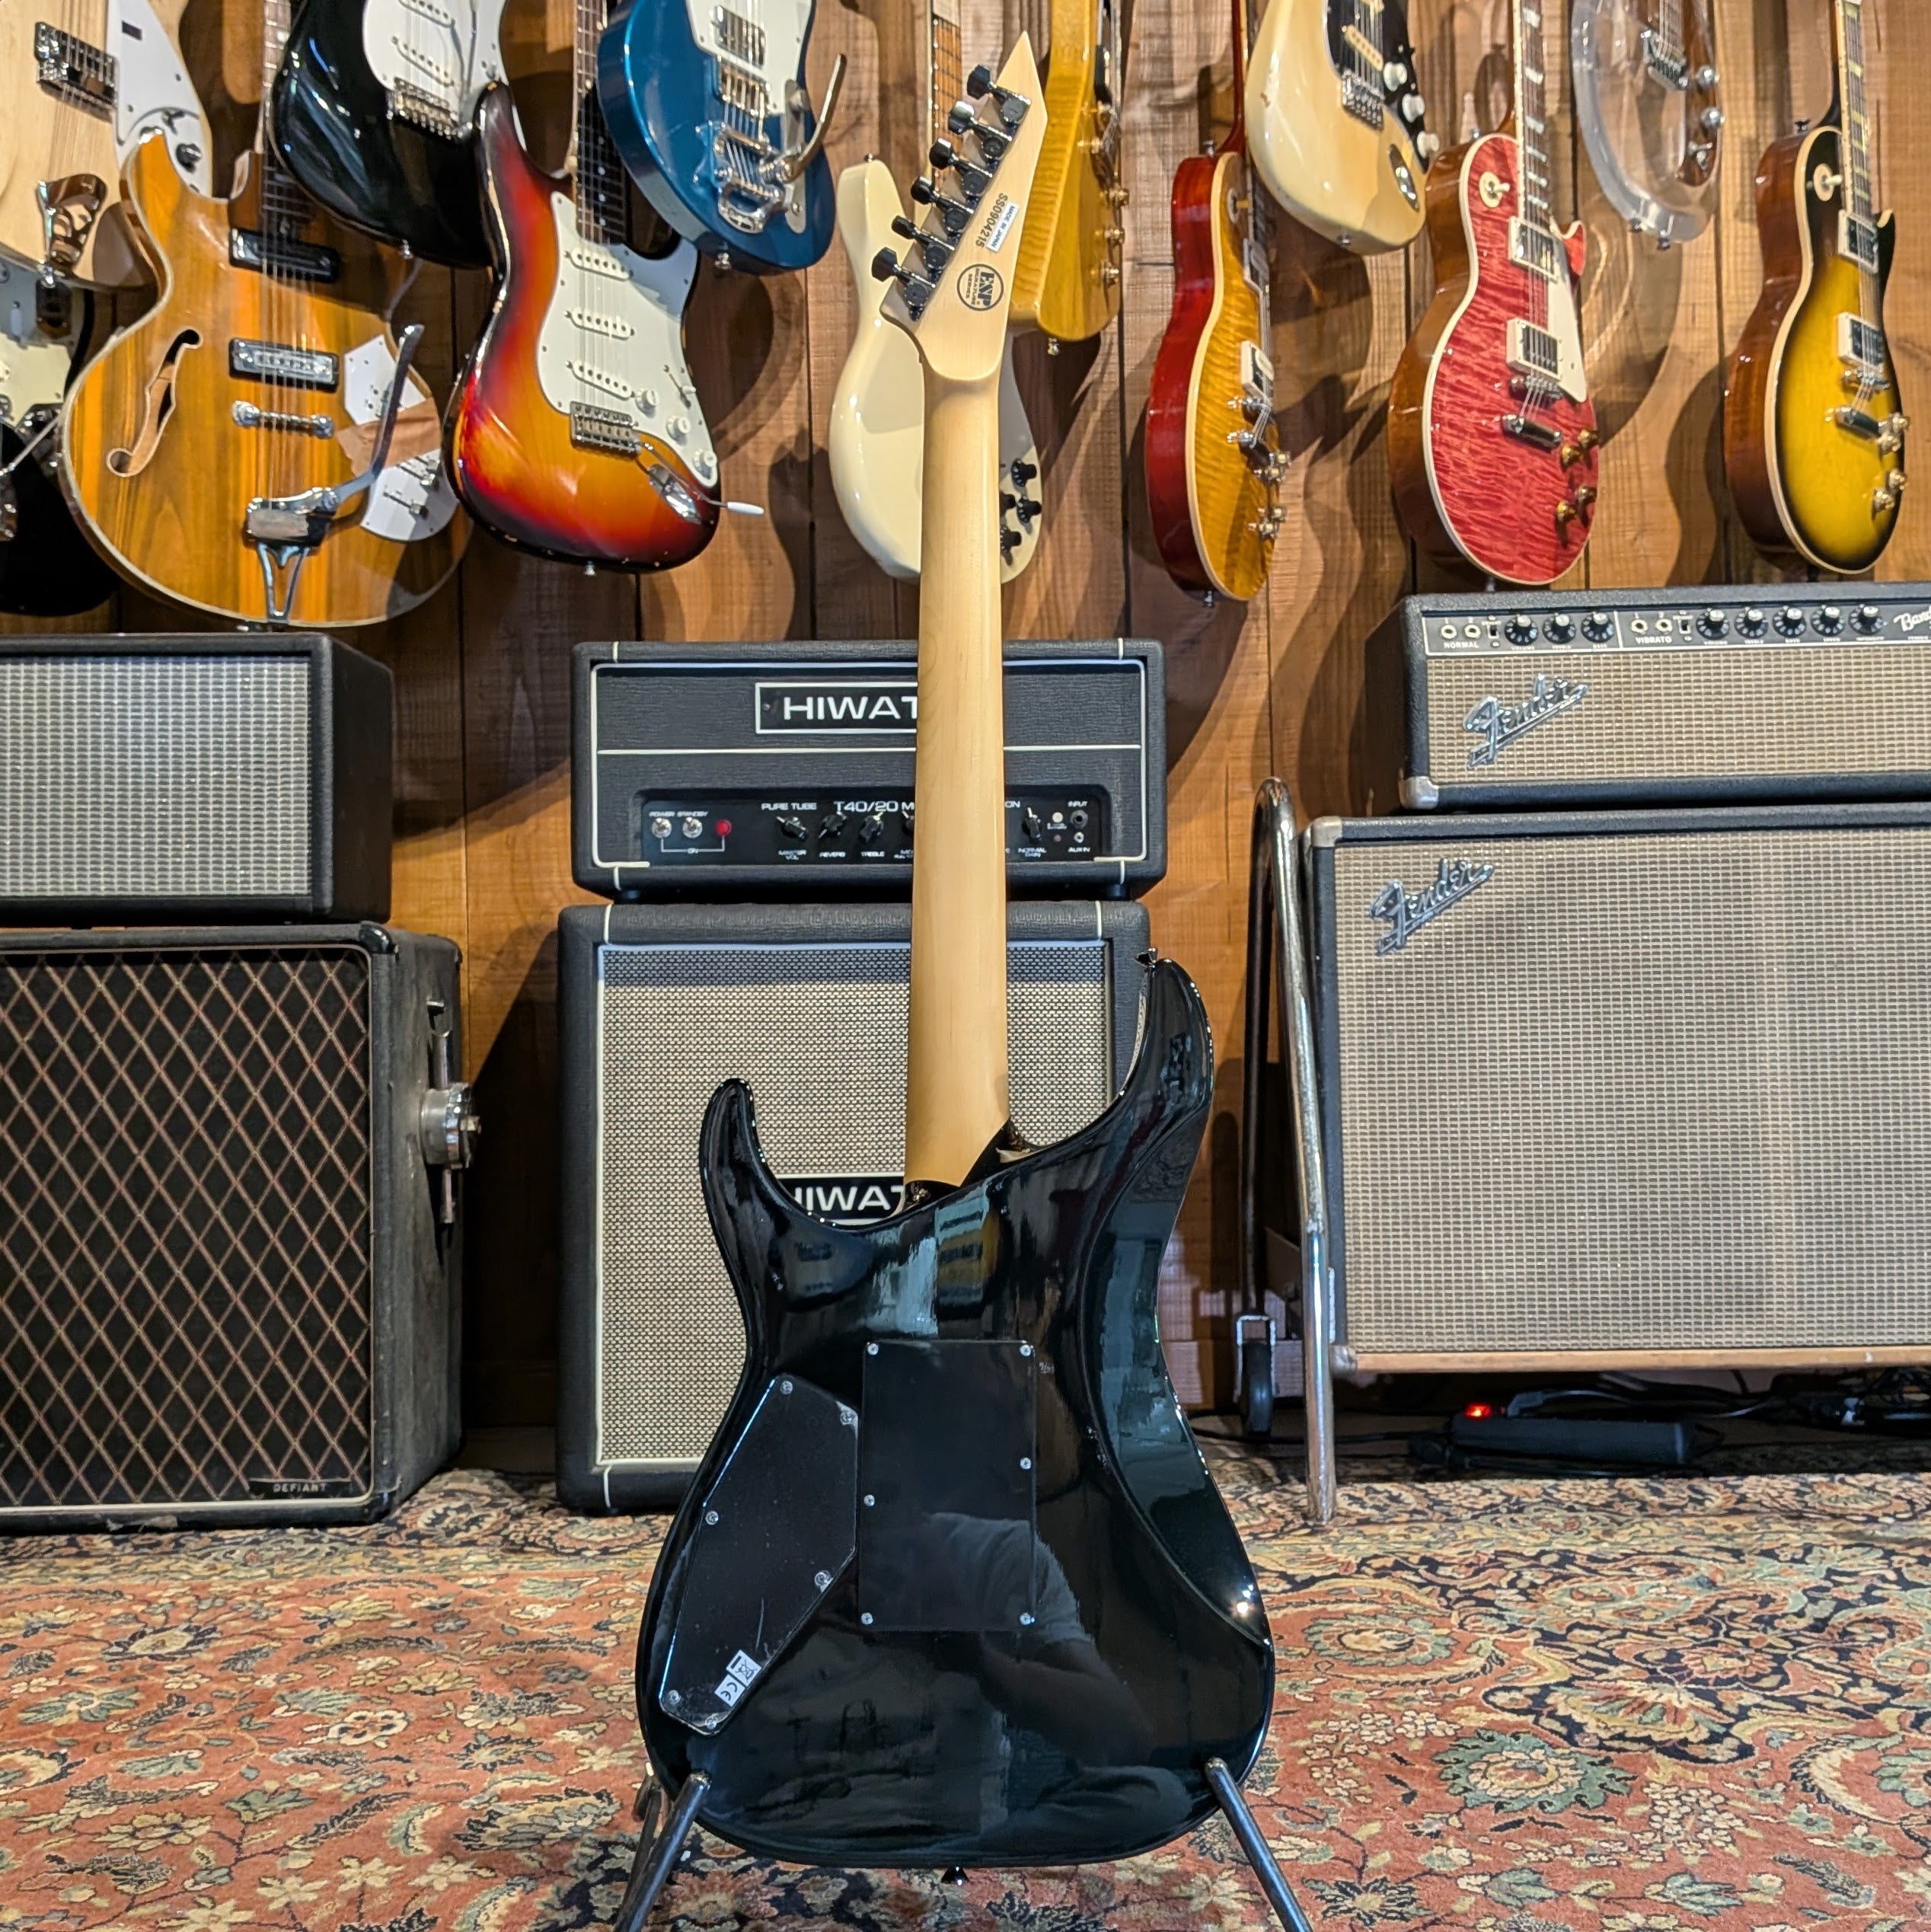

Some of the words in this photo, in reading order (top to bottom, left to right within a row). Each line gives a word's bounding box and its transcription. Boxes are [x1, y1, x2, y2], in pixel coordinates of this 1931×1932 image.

[975, 193, 1008, 247] SS0904215
[978, 271, 994, 306] ESP
[1635, 635, 1672, 644] VIBRATO
[1463, 673, 1589, 770] Fender
[761, 802, 788, 811] PURE
[791, 802, 817, 810] TUBE
[833, 800, 898, 813] T40/20
[1371, 857, 1495, 956] Fender
[273, 1483, 327, 1493] DEFIANT
